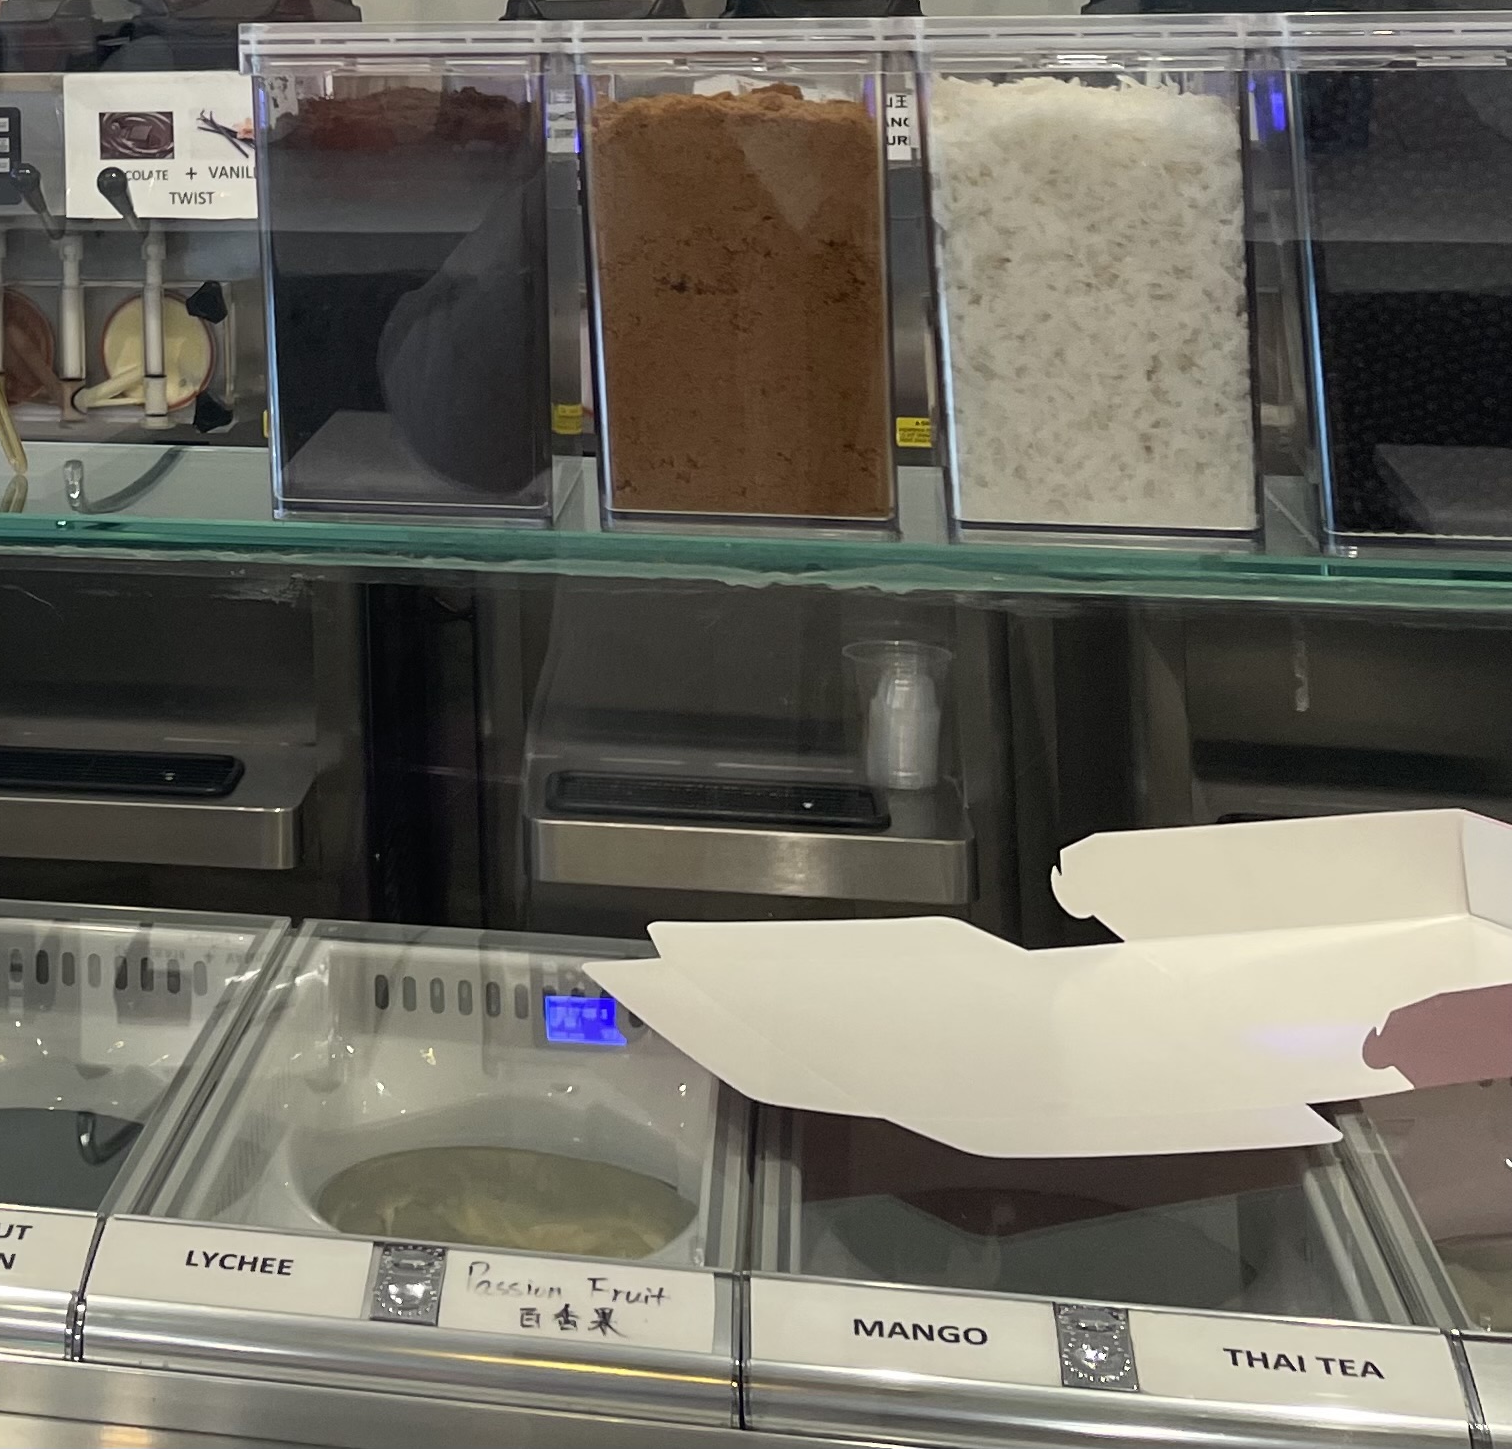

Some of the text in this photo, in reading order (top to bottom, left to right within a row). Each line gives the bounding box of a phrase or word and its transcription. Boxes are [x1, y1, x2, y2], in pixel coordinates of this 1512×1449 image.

[125, 168, 169, 181] COLATE
[169, 192, 216, 205] TWIST
[185, 1250, 294, 1277] LYCHEE
[466, 1260, 671, 1306] Passion Fruit
[518, 1303, 627, 1337] 百香果
[852, 1318, 988, 1346] MANGO
[1223, 1348, 1384, 1380] THAI TEA
